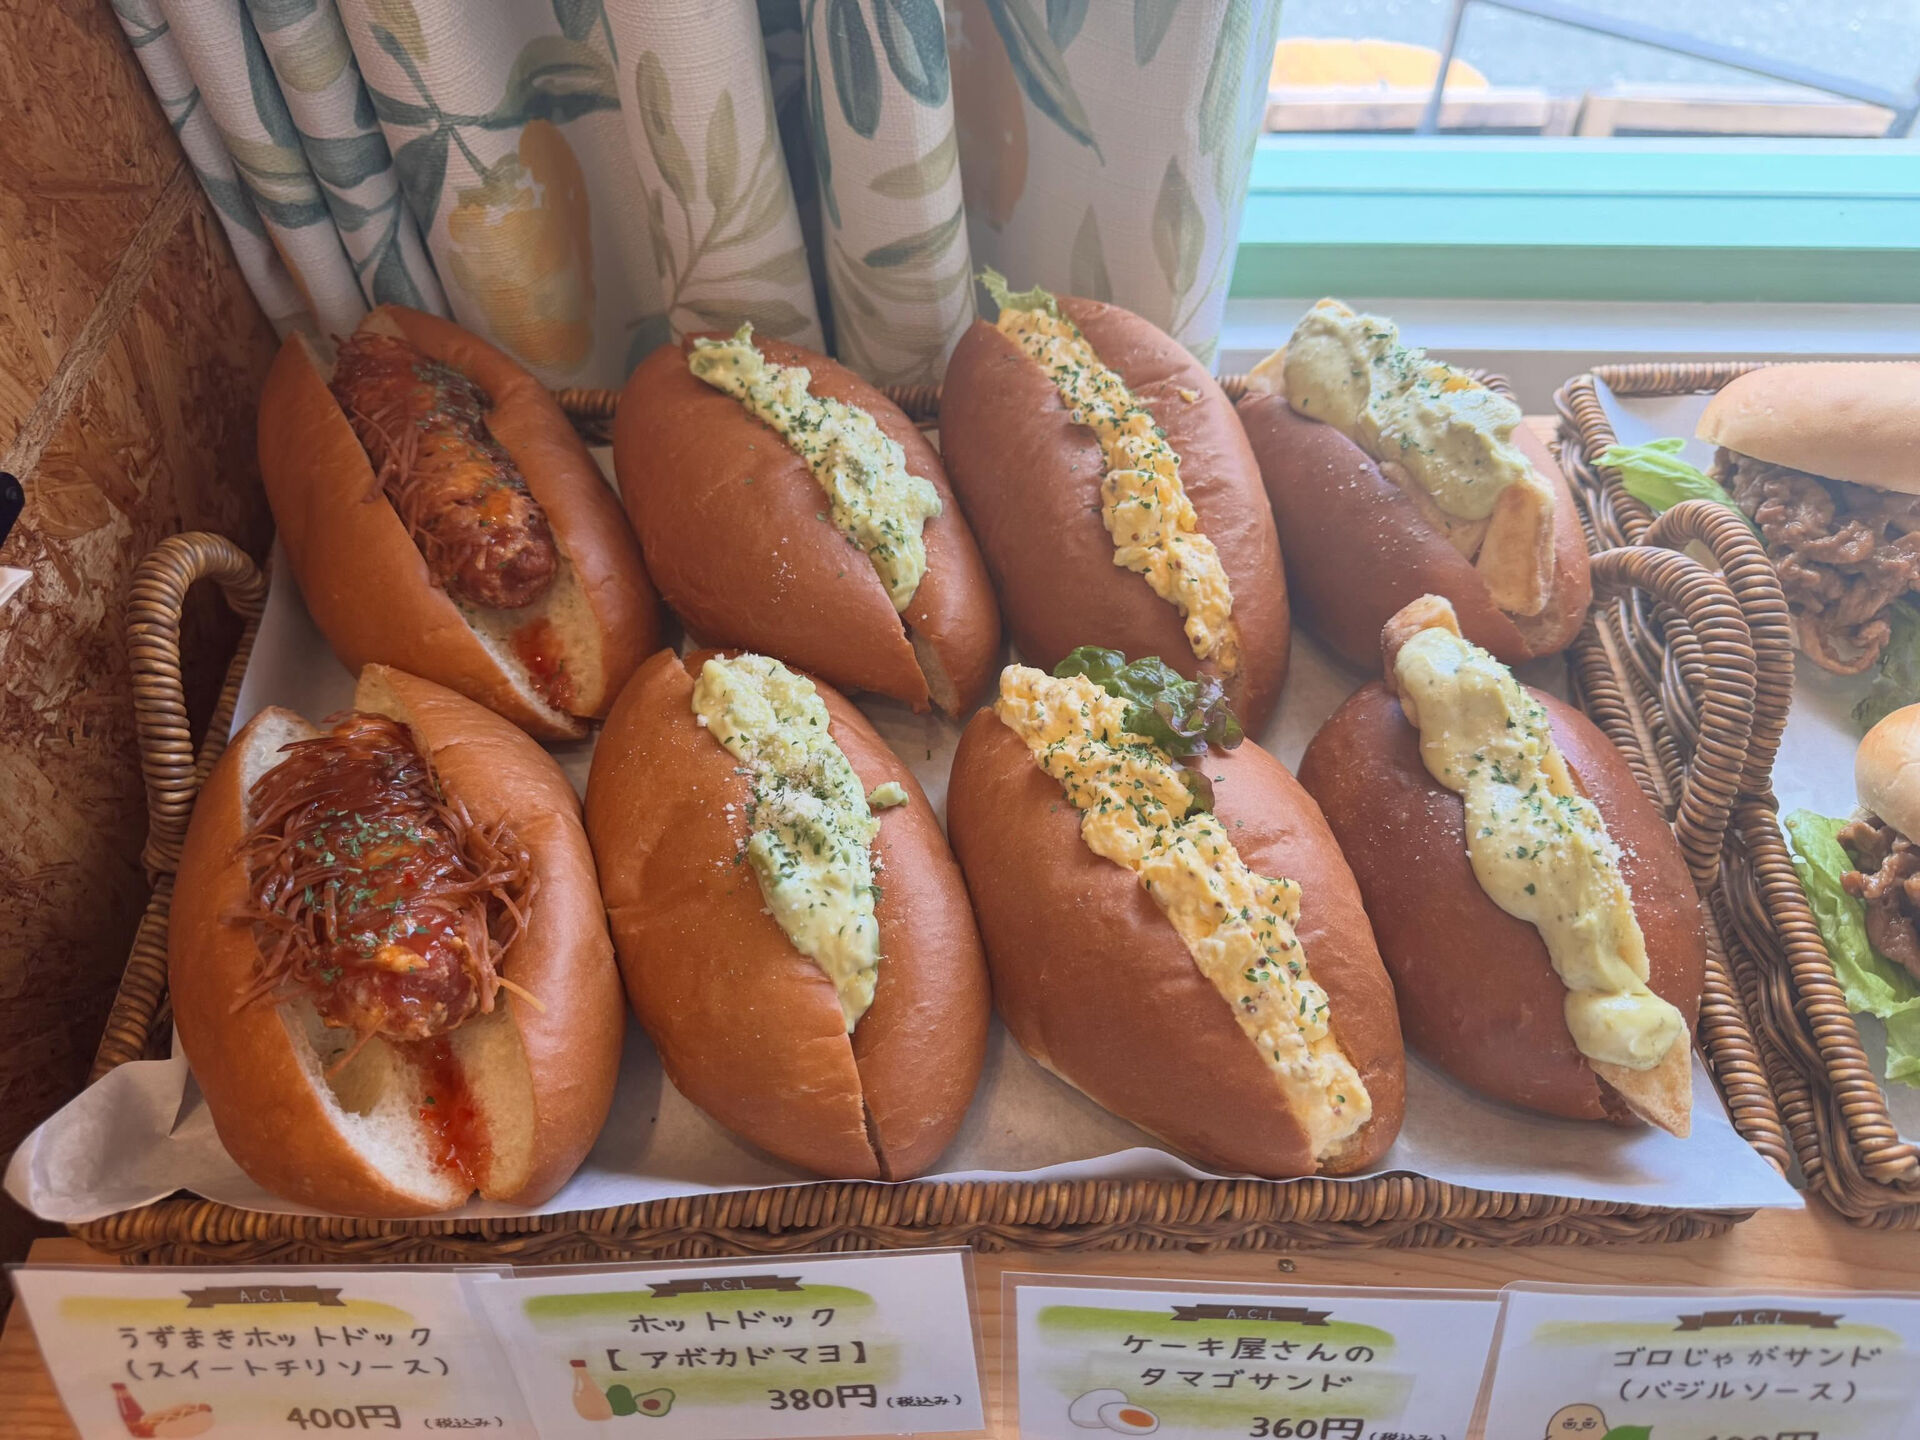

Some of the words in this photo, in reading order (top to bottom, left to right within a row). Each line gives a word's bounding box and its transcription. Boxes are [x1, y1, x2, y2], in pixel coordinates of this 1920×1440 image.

[629, 1308, 836, 1334] ホットドック
[117, 1326, 432, 1350] うずまきホットドック
[1122, 1334, 1374, 1363] ケーキ屋さんの
[1613, 1346, 1883, 1368] ゴロじゃがサンド
[1140, 1367, 1353, 1393] タマゴサンド
[767, 1384, 878, 1411] 380円
[286, 1404, 402, 1430] 400円
[1249, 1416, 1365, 1440] 360円
